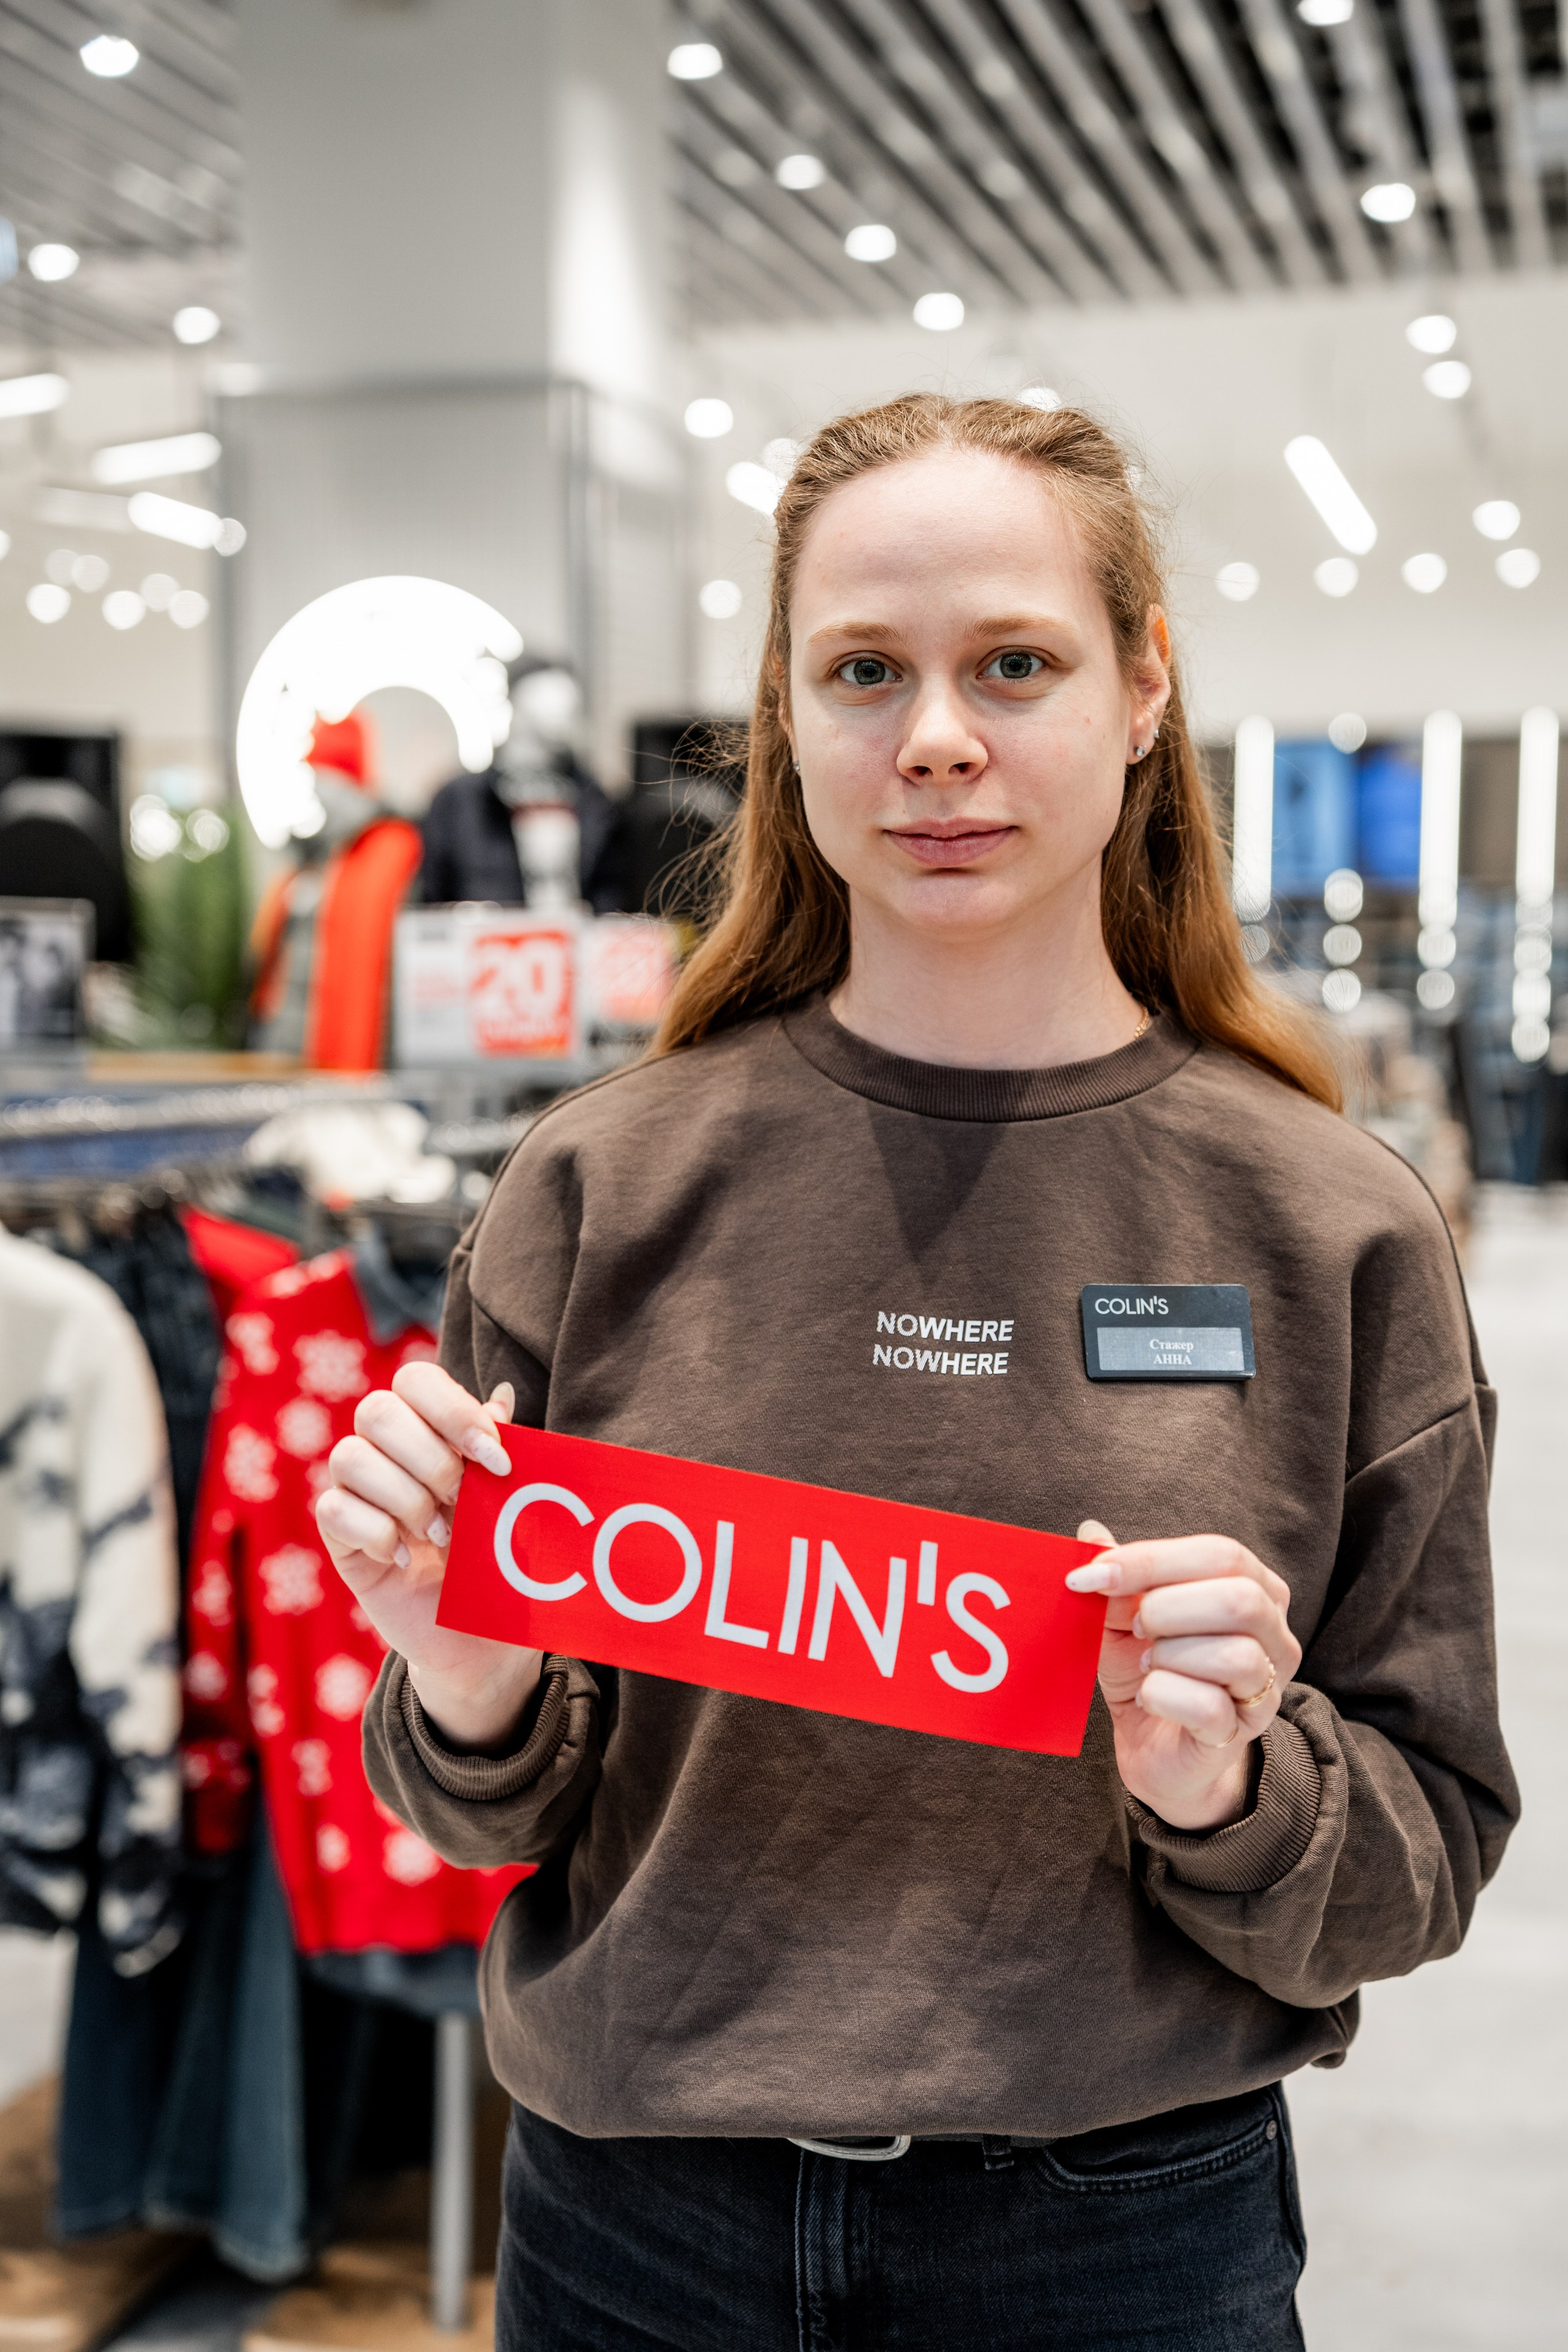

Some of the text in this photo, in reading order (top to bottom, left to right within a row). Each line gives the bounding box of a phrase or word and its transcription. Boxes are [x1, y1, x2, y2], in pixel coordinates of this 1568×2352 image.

[1095, 1295, 1169, 1315] COLIN'S
[876, 1311, 1014, 1342] NOWHERE
[1148, 1339, 1194, 1352] Стажер
[872, 1343, 1009, 1376] NOWHERE
[1153, 1354, 1193, 1365] АННА
[493, 1482, 1011, 1694] COLIN'S
